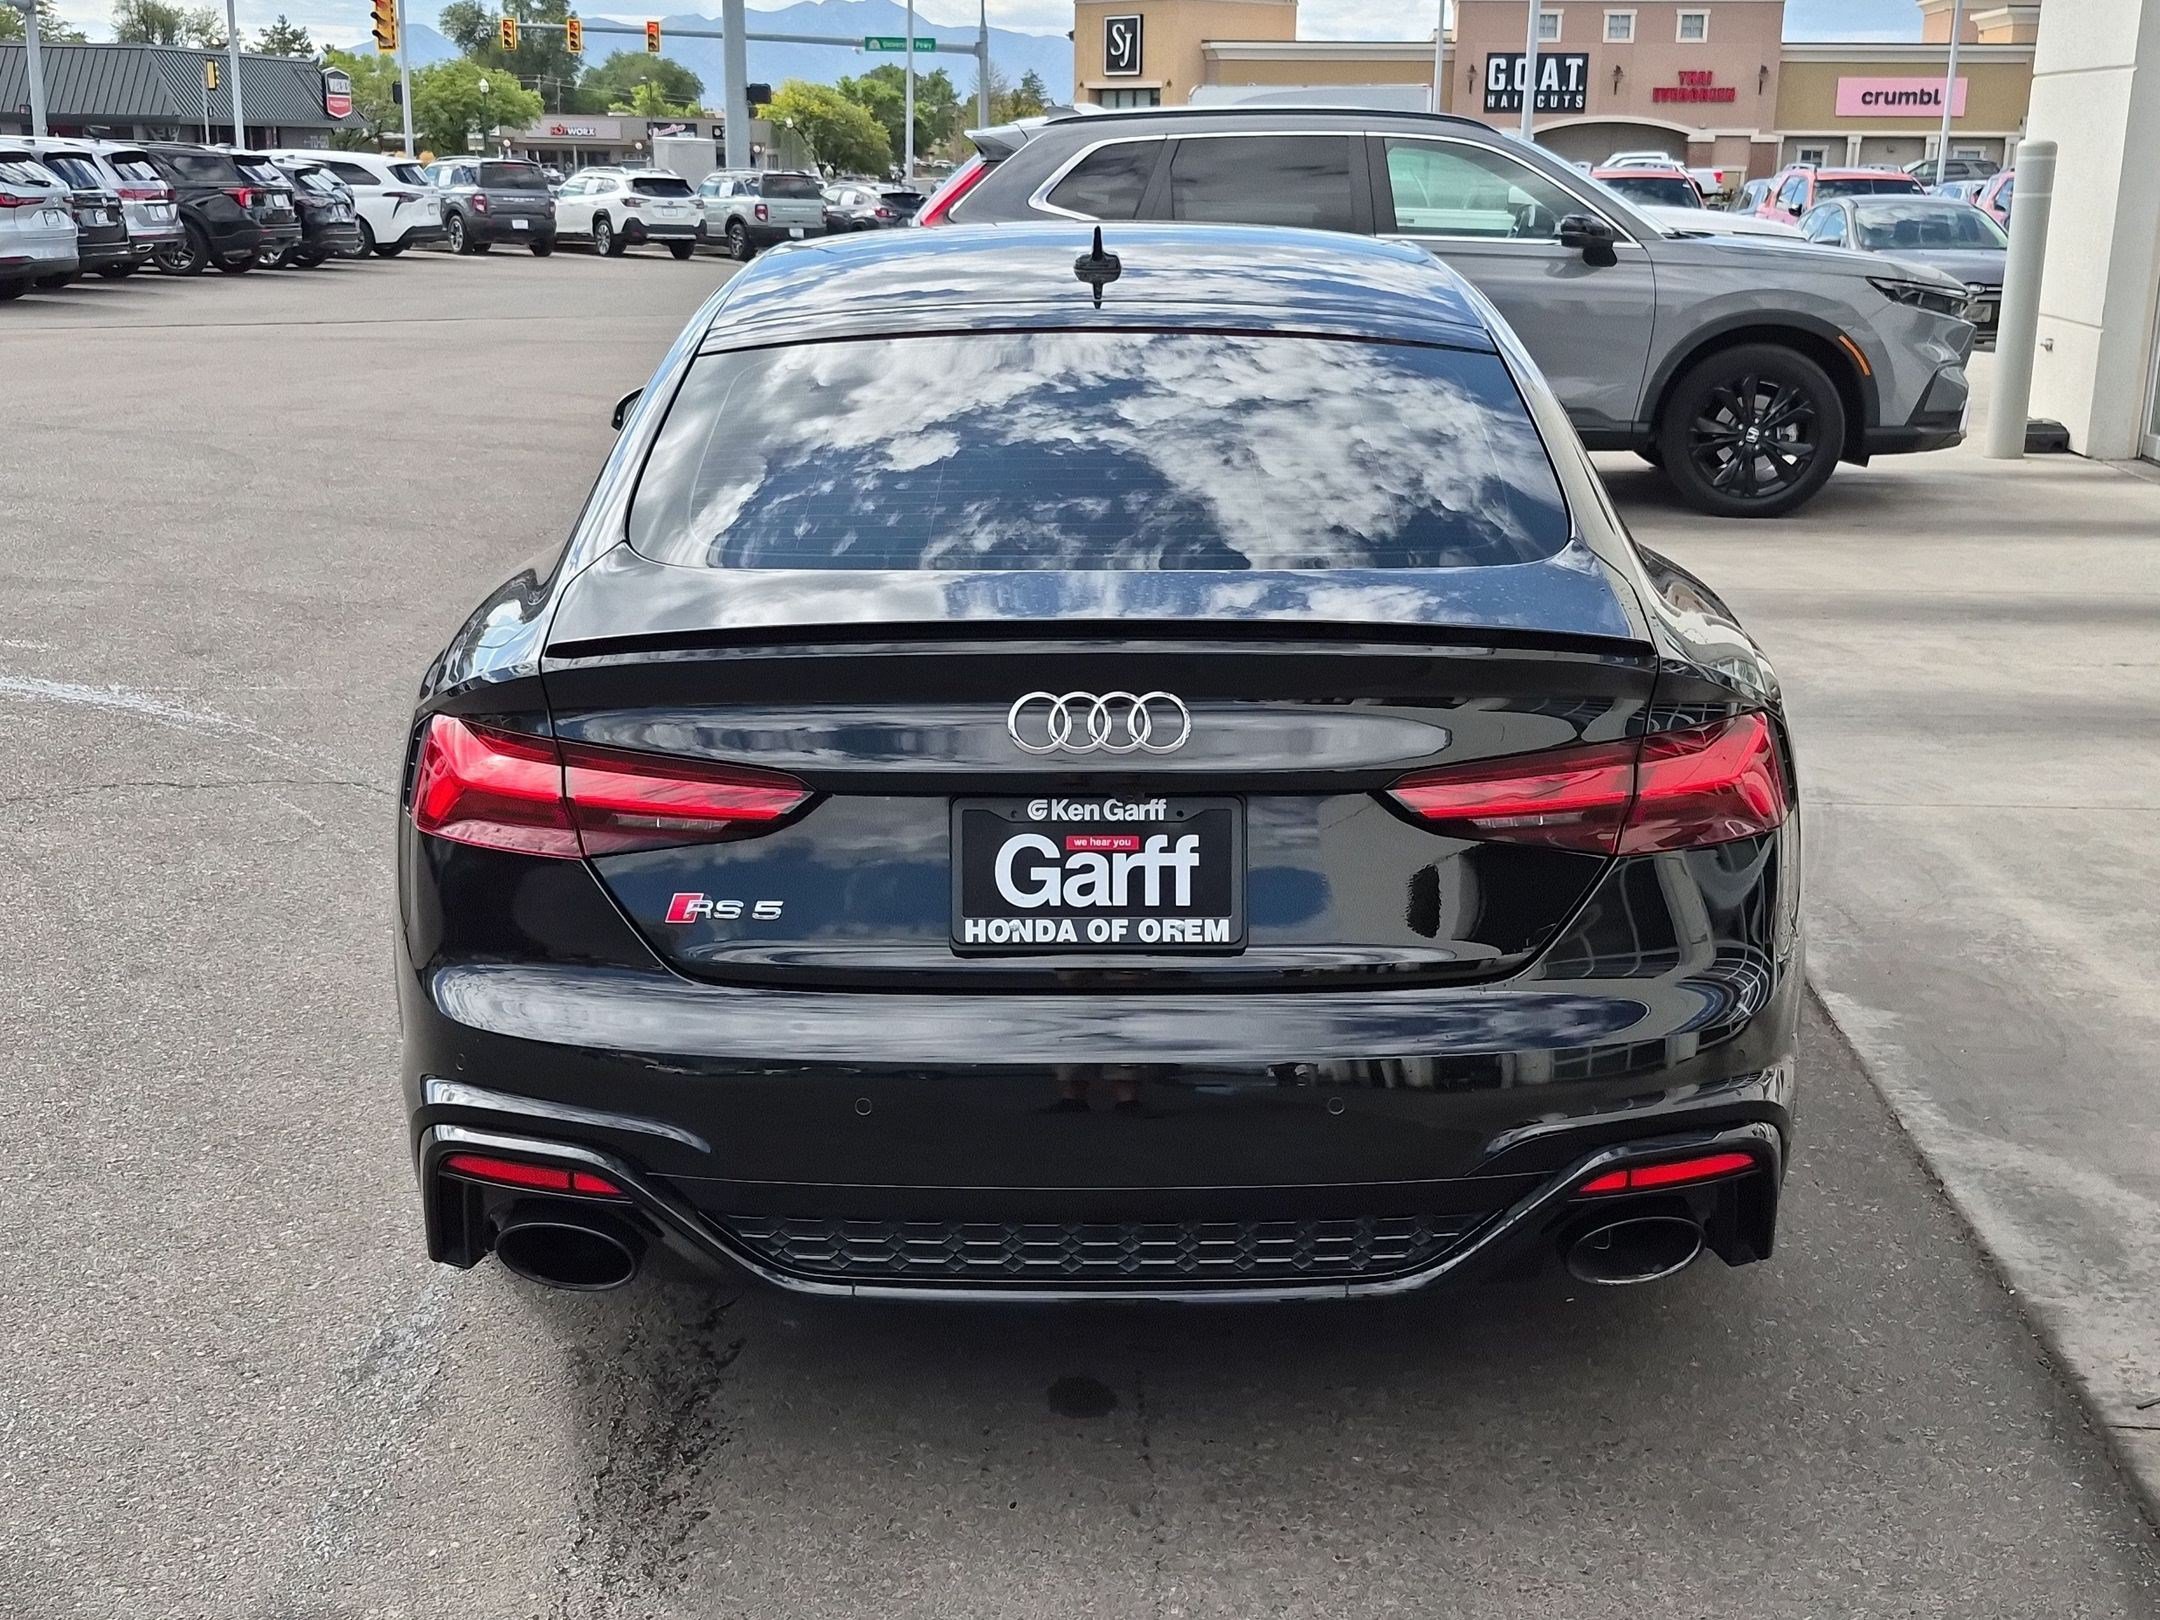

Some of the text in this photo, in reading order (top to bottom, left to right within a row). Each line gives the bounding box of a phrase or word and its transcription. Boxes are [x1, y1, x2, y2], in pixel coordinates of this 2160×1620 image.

[1110, 24, 1132, 67] SJ
[1487, 94, 1584, 108] HAICUTS
[1861, 88, 1941, 105] crumbl
[1051, 798, 1167, 821] Ken Garff
[1074, 837, 1131, 848] we hear you
[994, 833, 1200, 908] Garff
[683, 899, 784, 920] RS 5
[964, 918, 1230, 944] HONDA OF OREM
